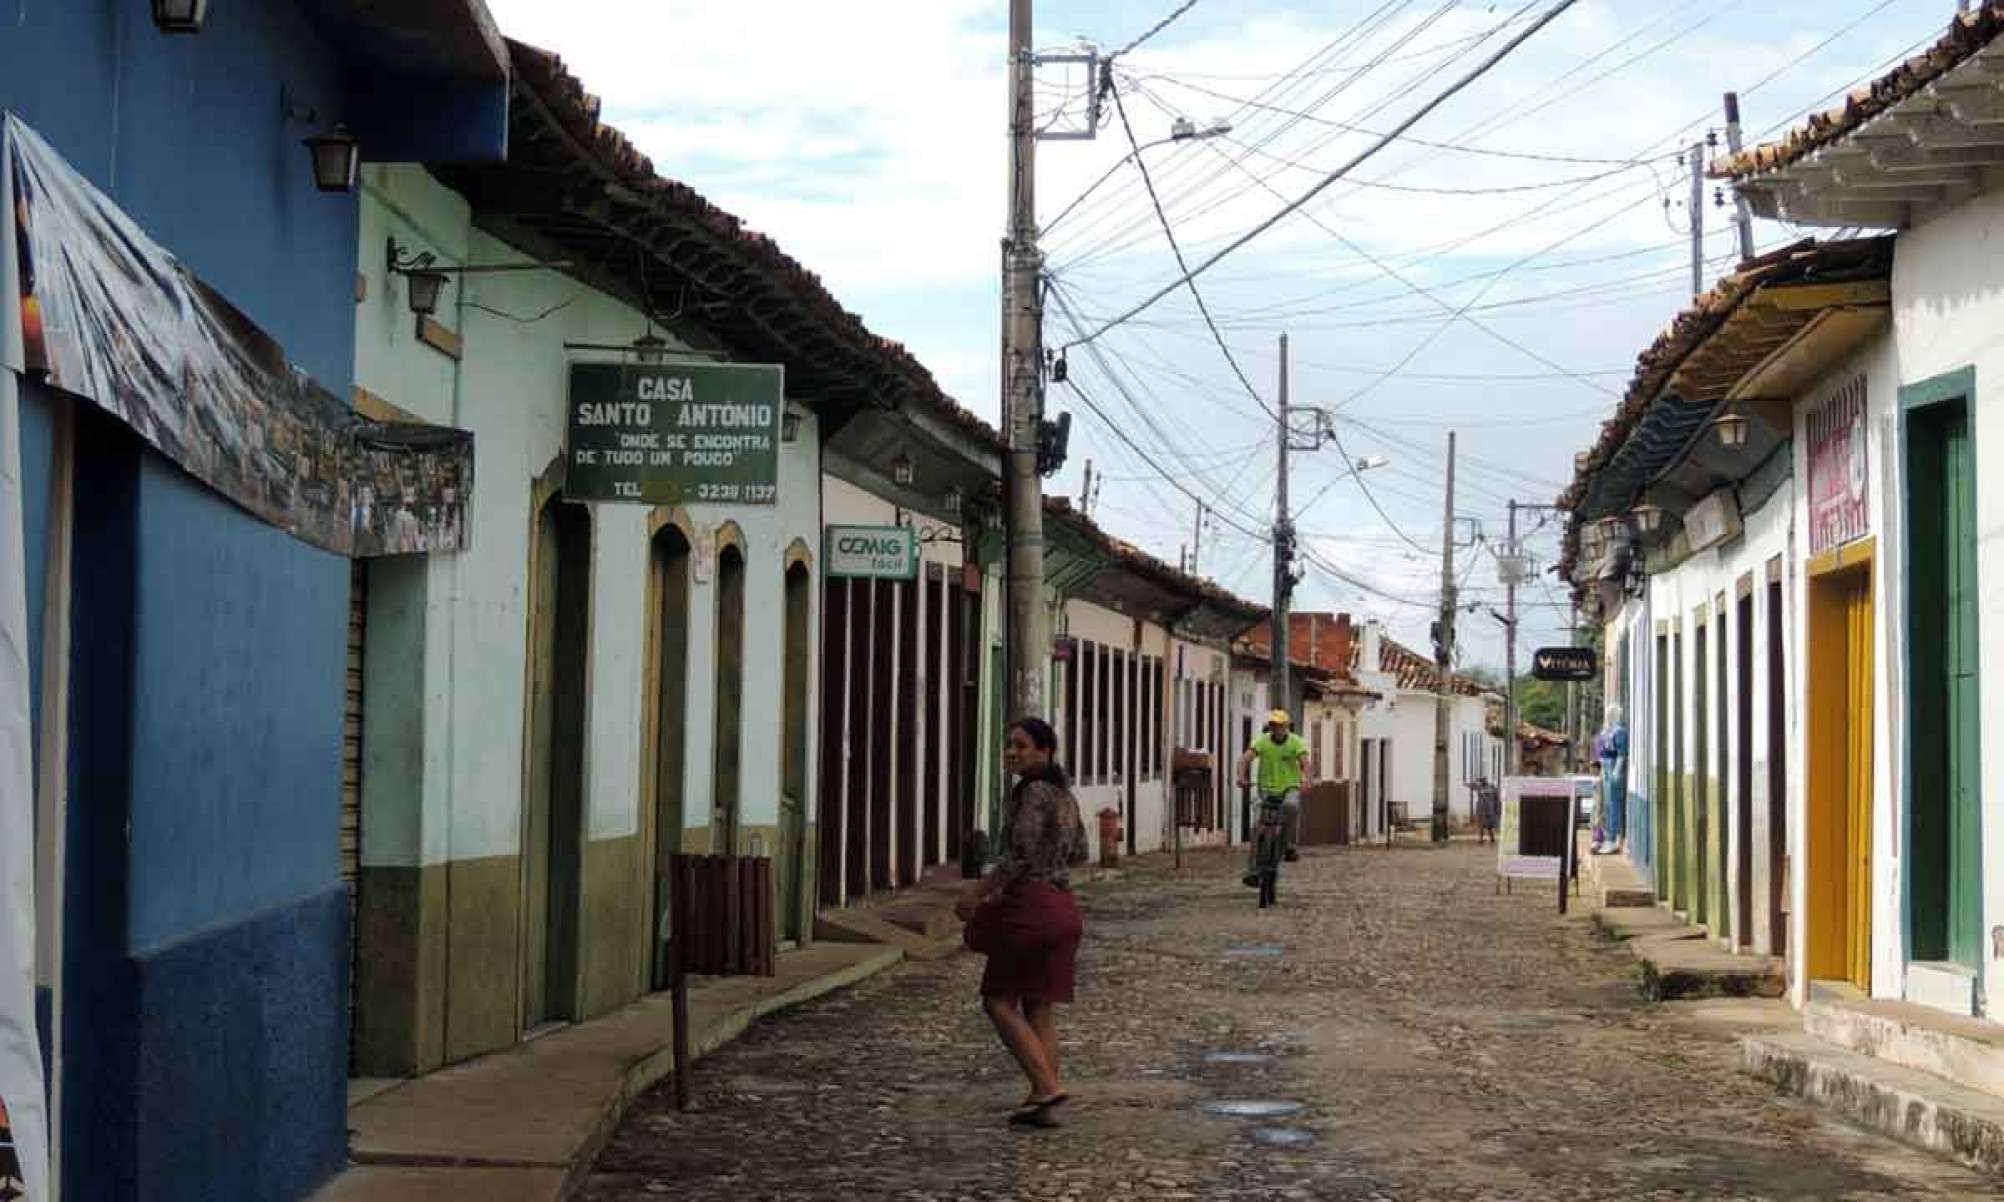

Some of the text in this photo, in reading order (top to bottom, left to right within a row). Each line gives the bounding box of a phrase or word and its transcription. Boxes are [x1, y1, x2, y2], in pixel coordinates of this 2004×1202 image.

[637, 377, 694, 401] CASA
[577, 403, 650, 426] SANTO
[667, 433, 688, 449] SE
[693, 434, 771, 451] ENCONTRA
[575, 451, 597, 465] DE
[605, 451, 644, 466] TUDO
[650, 452, 671, 467] UM
[839, 537, 904, 555] CEMIG
